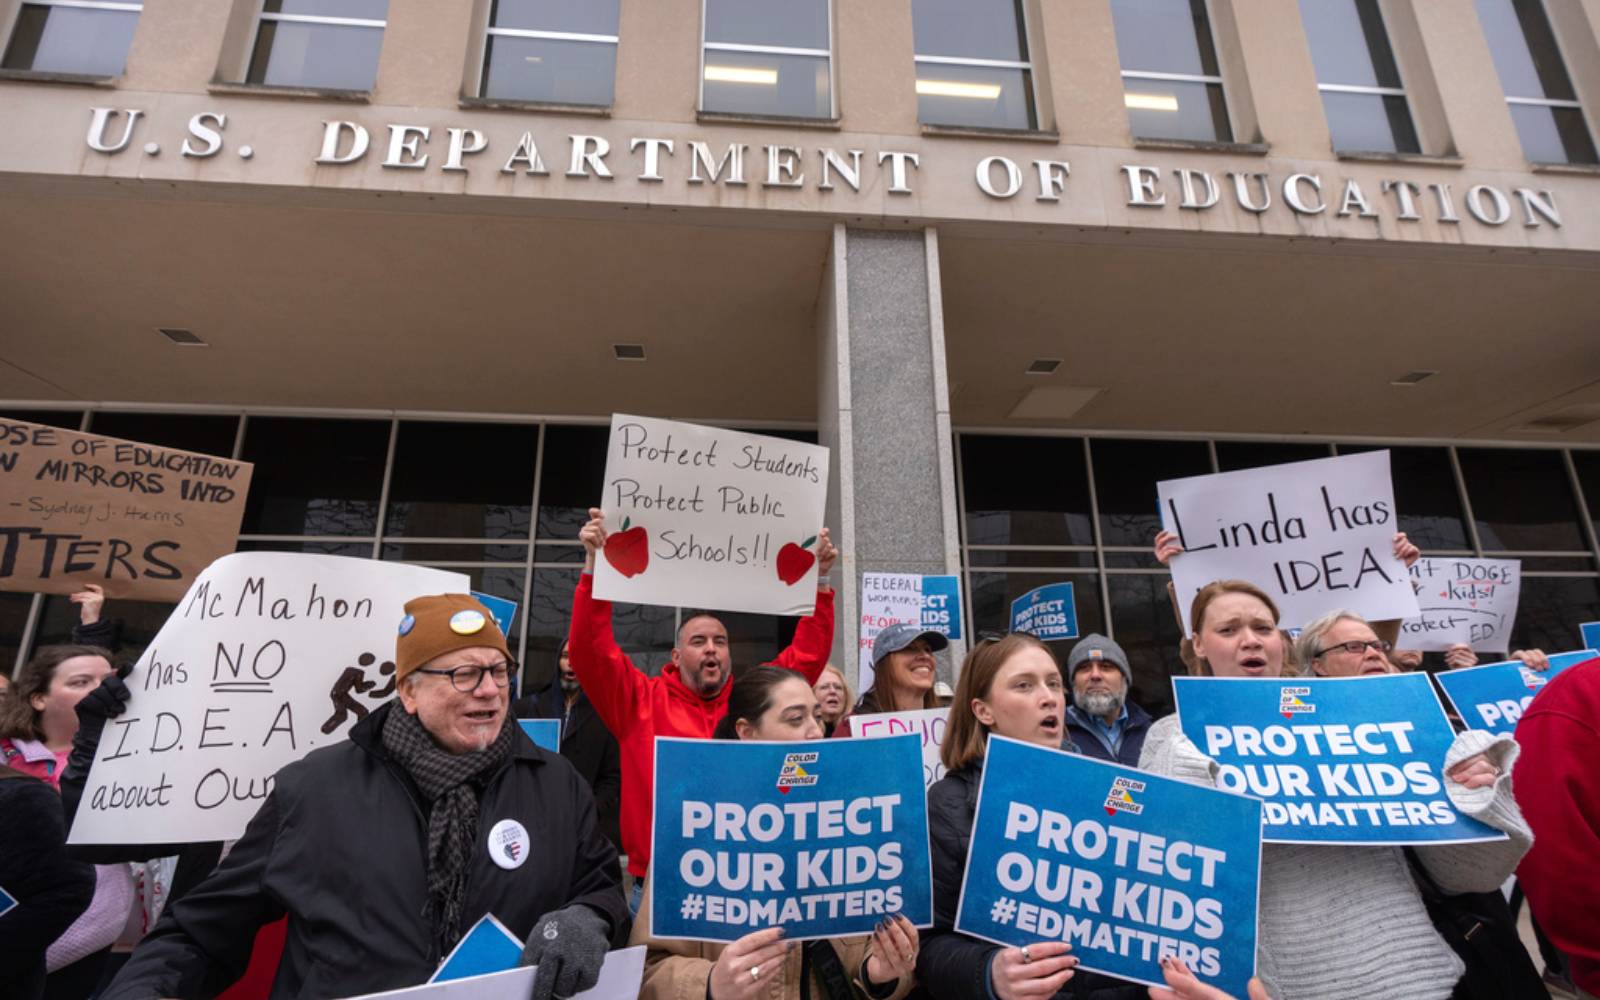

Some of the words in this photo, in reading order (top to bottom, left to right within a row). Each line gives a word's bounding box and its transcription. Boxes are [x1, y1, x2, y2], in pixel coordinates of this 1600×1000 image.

[86, 106, 255, 160] U.S.
[314, 118, 920, 195] DEPARTMENT
[975, 155, 1071, 202] OF
[1122, 164, 1563, 229] EDUCATION
[71, 439, 108, 457] OF
[115, 444, 240, 480] EDUCATION
[618, 423, 717, 467] Protect
[733, 445, 819, 483] Students
[36, 459, 164, 494] MIRRORS
[181, 478, 235, 504] INTO
[611, 478, 704, 513] Protect
[717, 485, 785, 517] Public
[1168, 492, 1307, 553] Linda
[1320, 485, 1390, 532] has
[0, 527, 182, 580] TTERS
[654, 530, 770, 568] Schools!!
[863, 577, 922, 592] FEDERAL
[1408, 559, 1440, 578] n't
[1454, 561, 1513, 585] DOGE
[1447, 580, 1496, 605] kids!
[920, 610, 950, 624] IDS
[1015, 599, 1064, 625] PROTECT
[1028, 624, 1069, 636] ATTERS
[1033, 612, 1067, 627] KIDS
[1402, 615, 1469, 633] rotect
[144, 649, 188, 691] has
[211, 639, 286, 682] NO
[1205, 721, 1413, 756] PROTECT
[783, 766, 796, 774] OF
[787, 754, 817, 762] COLOR
[91, 772, 173, 811] about
[779, 776, 817, 785] CHANGE
[1111, 788, 1124, 796] OF
[1116, 778, 1143, 790] COLOR
[1217, 764, 1315, 797] OUR
[1317, 761, 1440, 797] KIDS
[682, 794, 901, 842] PROTECT
[1107, 799, 1140, 812] CHANGE
[1262, 800, 1457, 826] DMATTERS
[1004, 801, 1226, 888] PROTECT
[679, 848, 785, 892] OUR
[796, 841, 903, 889] KIDS
[680, 886, 904, 927] #EDMATTERS
[996, 852, 1103, 913] OUR
[1111, 878, 1224, 940] KIDS
[990, 896, 1221, 978] #EDMATTERS
